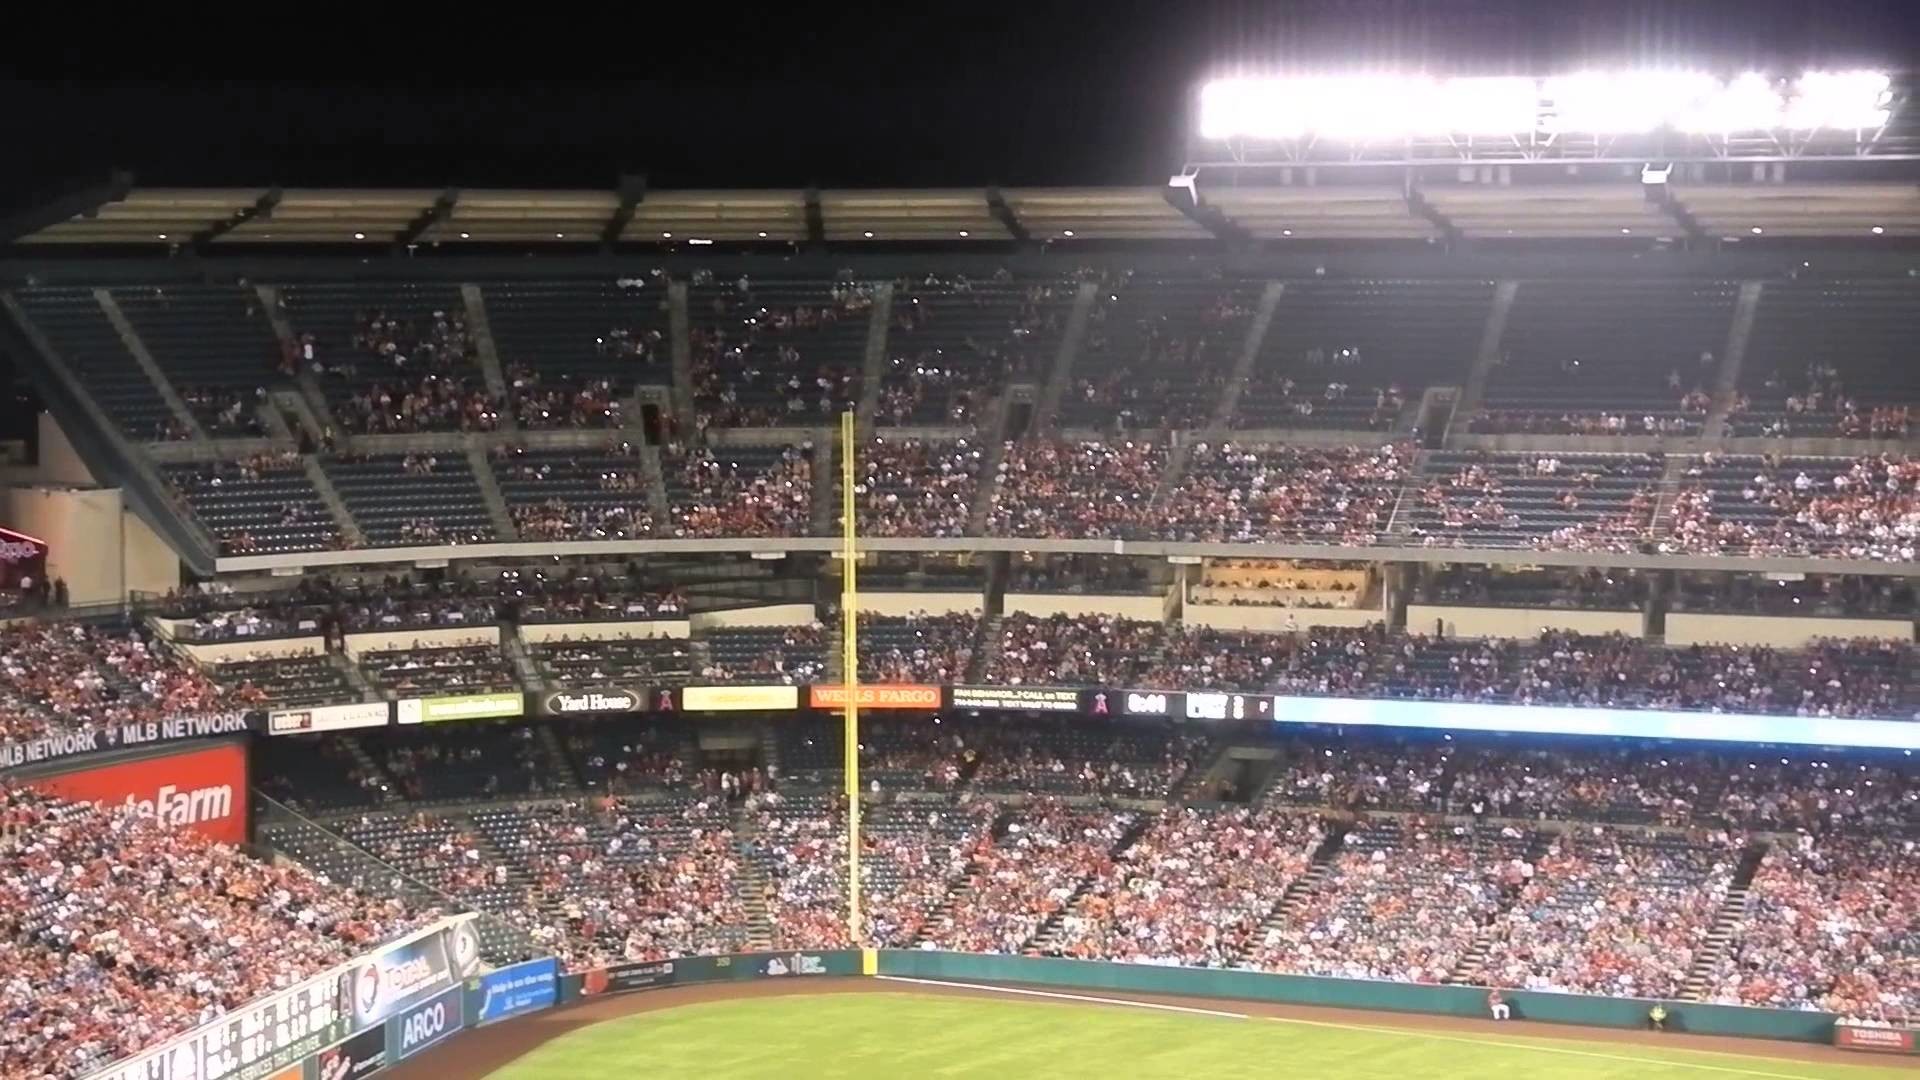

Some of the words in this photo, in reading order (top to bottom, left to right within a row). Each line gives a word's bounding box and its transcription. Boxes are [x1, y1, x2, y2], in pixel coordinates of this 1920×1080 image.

[557, 694, 589, 711] Yard
[590, 693, 631, 710] House
[880, 689, 937, 703] FARGO
[1055, 691, 1077, 701] TEXT
[122, 722, 158, 744] MLB
[161, 711, 249, 739] NETWORK
[26, 731, 98, 762] NETWORK
[157, 783, 233, 829] Farm
[402, 1002, 445, 1049] ARCO
